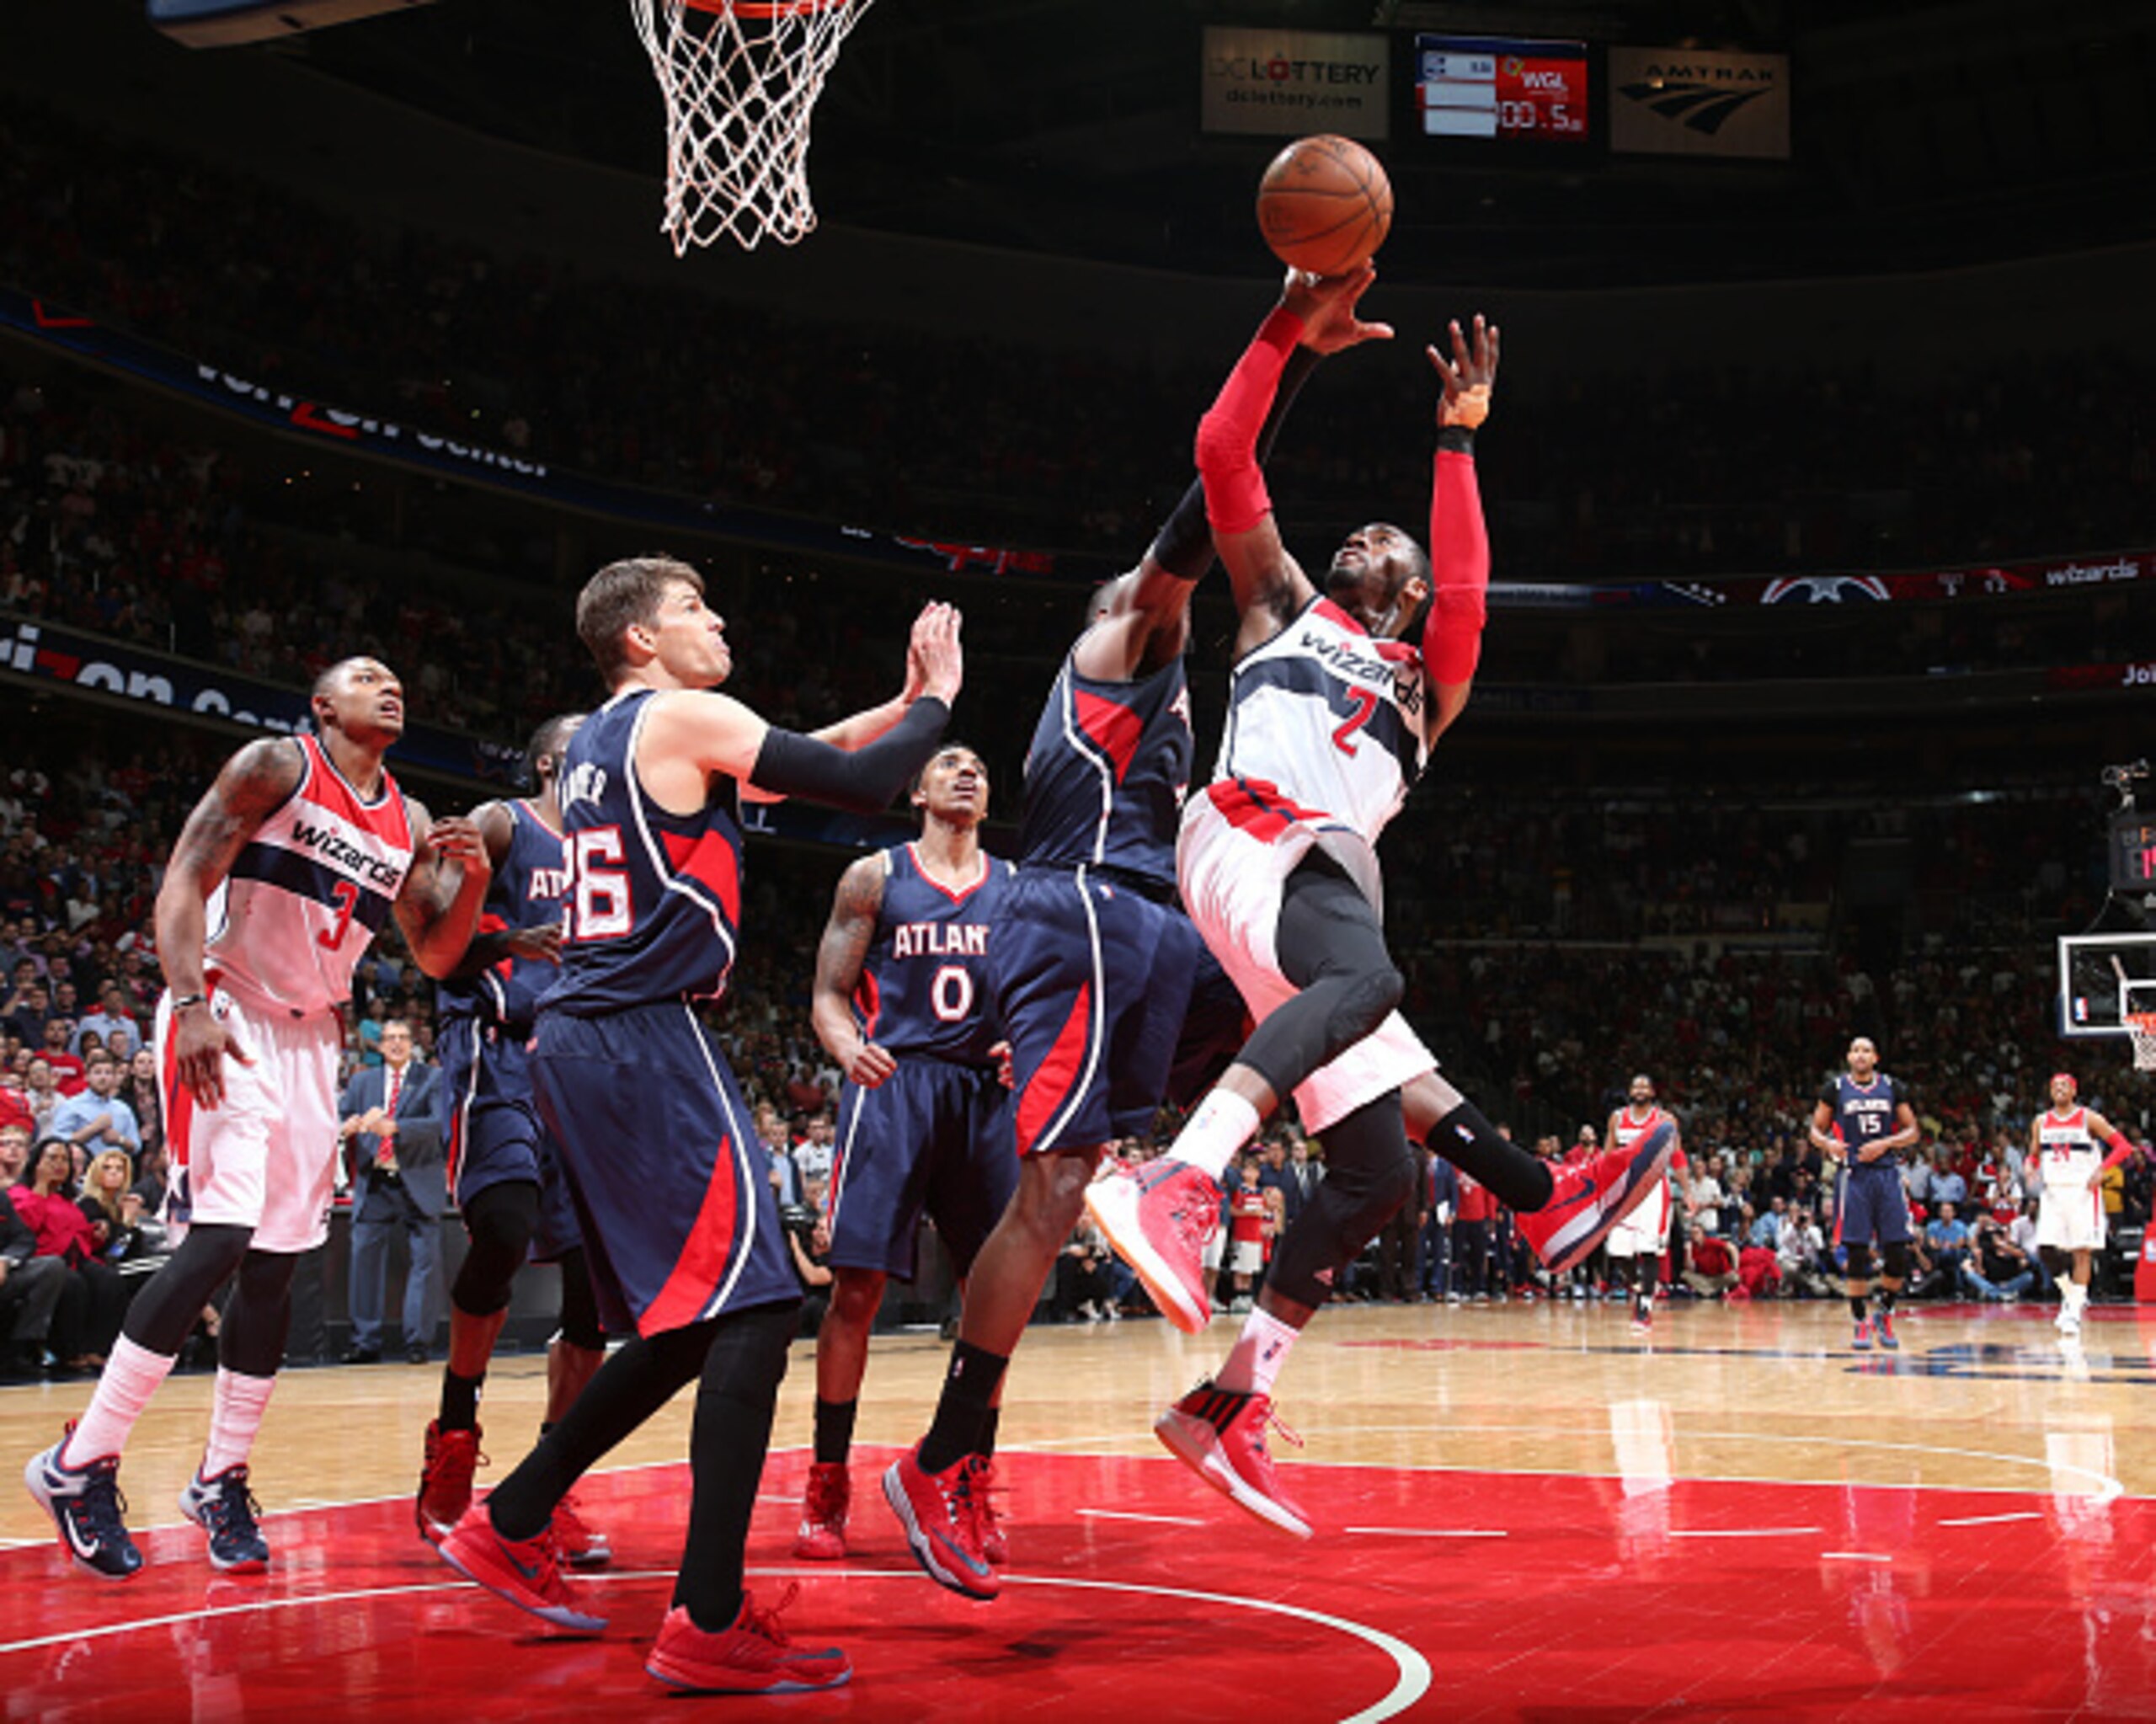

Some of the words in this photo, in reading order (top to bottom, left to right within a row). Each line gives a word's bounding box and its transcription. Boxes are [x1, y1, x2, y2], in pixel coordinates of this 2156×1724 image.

[1646, 64, 1773, 81] AMTRAK
[1332, 685, 1379, 758] 2
[291, 819, 403, 889] wizards
[317, 880, 360, 953] 3
[893, 921, 990, 958] ATLAN
[931, 965, 974, 1022] 0
[1857, 1113, 1882, 1134] 15
